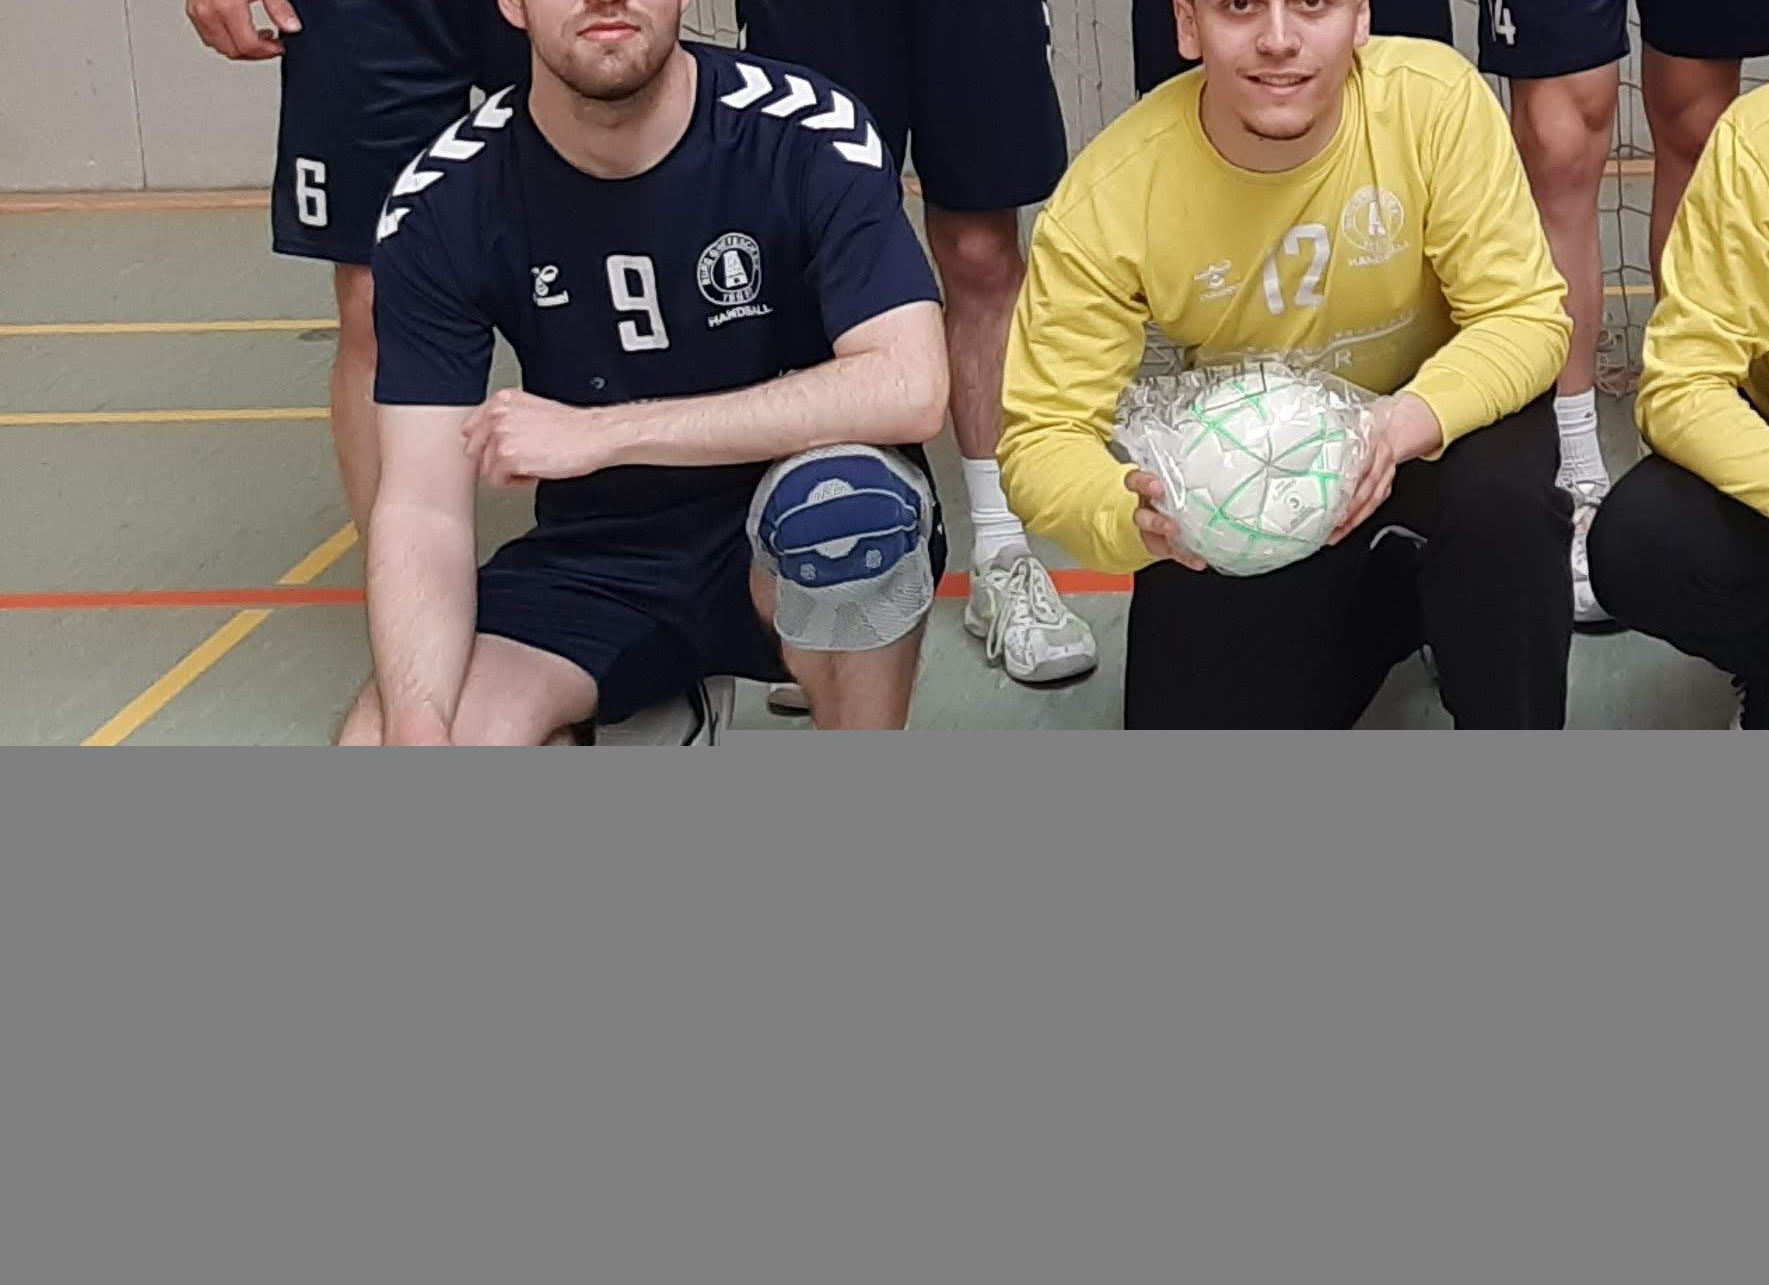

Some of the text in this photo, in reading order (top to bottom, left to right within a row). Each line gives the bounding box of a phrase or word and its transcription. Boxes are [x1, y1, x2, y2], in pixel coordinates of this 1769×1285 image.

[296, 157, 328, 226] 6
[606, 254, 669, 351] 9
[1260, 223, 1331, 315] 12
